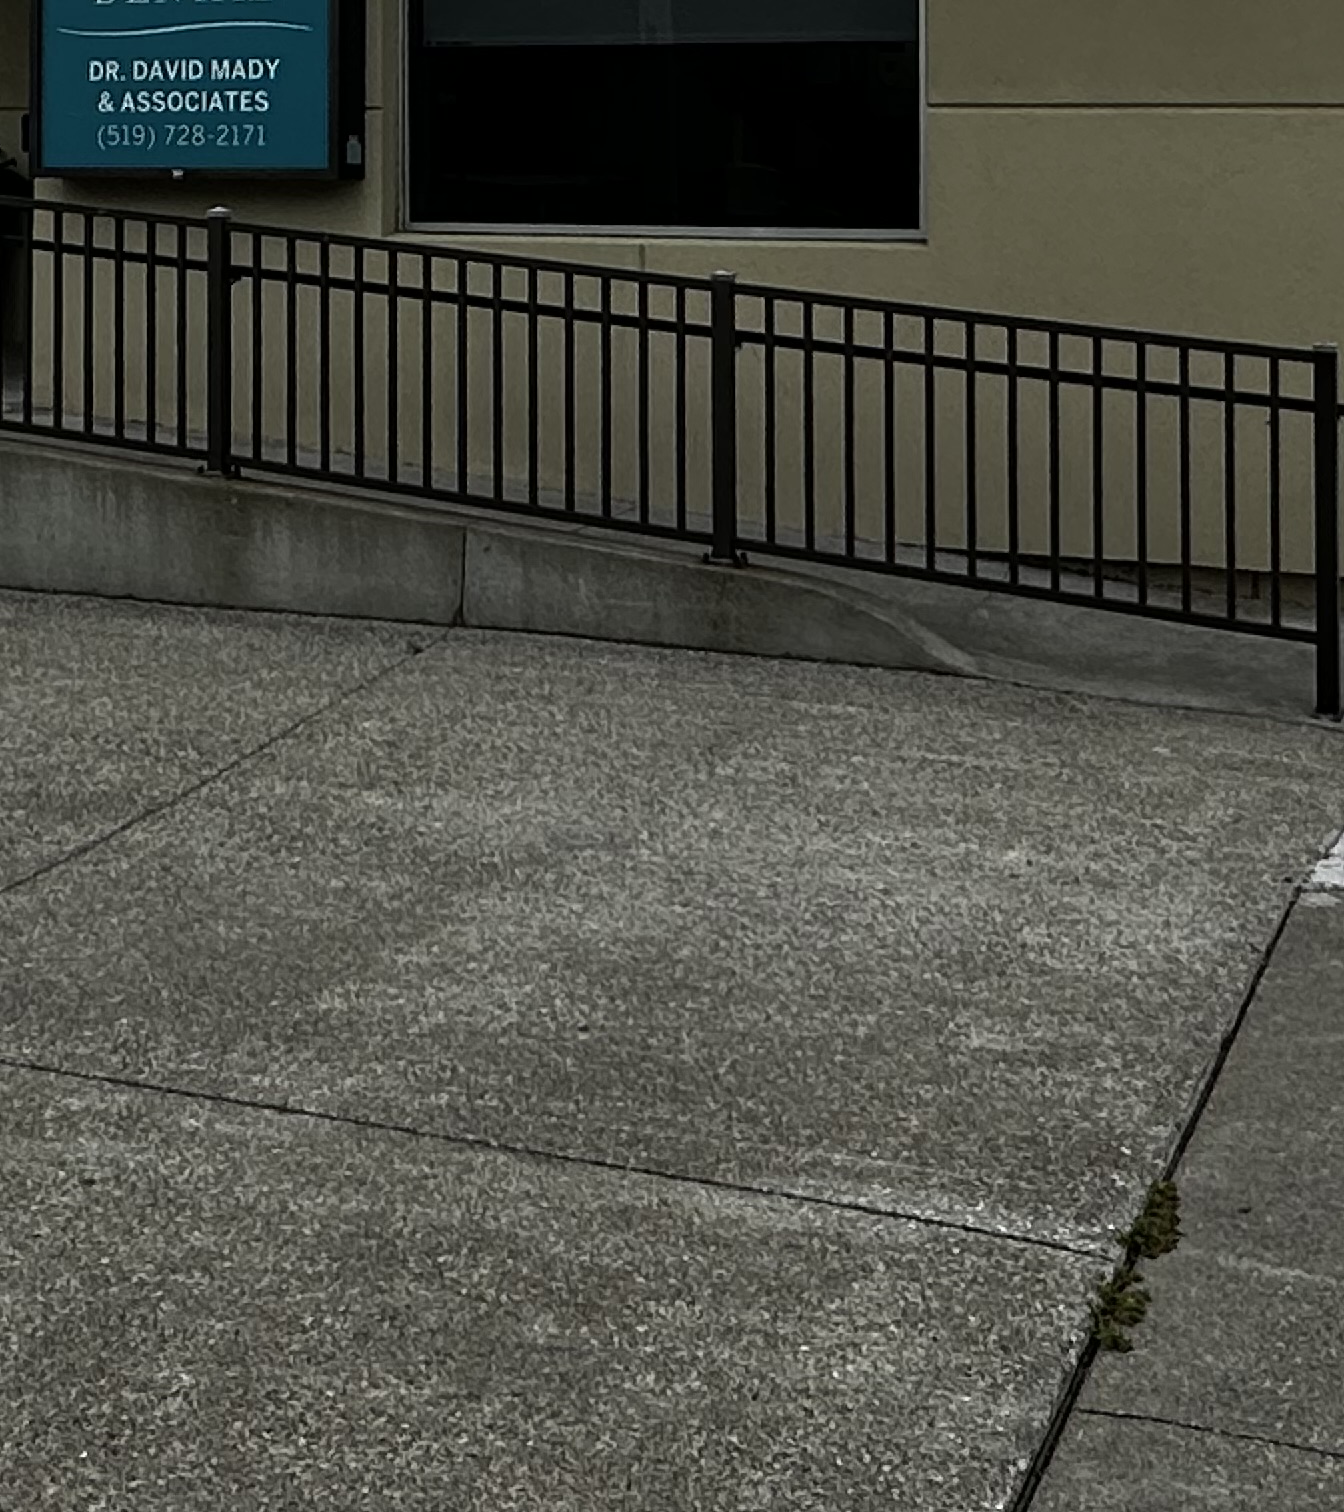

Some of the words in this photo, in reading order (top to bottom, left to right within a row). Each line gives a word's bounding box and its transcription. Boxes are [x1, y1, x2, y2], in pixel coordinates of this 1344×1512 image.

[88, 60, 126, 82] DR.
[132, 59, 204, 81] DAVID
[210, 58, 281, 80] MADY
[97, 92, 115, 113] &
[120, 90, 270, 112] ASSOCIATES
[96, 124, 156, 150] (519)
[163, 124, 266, 147] 728-2171
